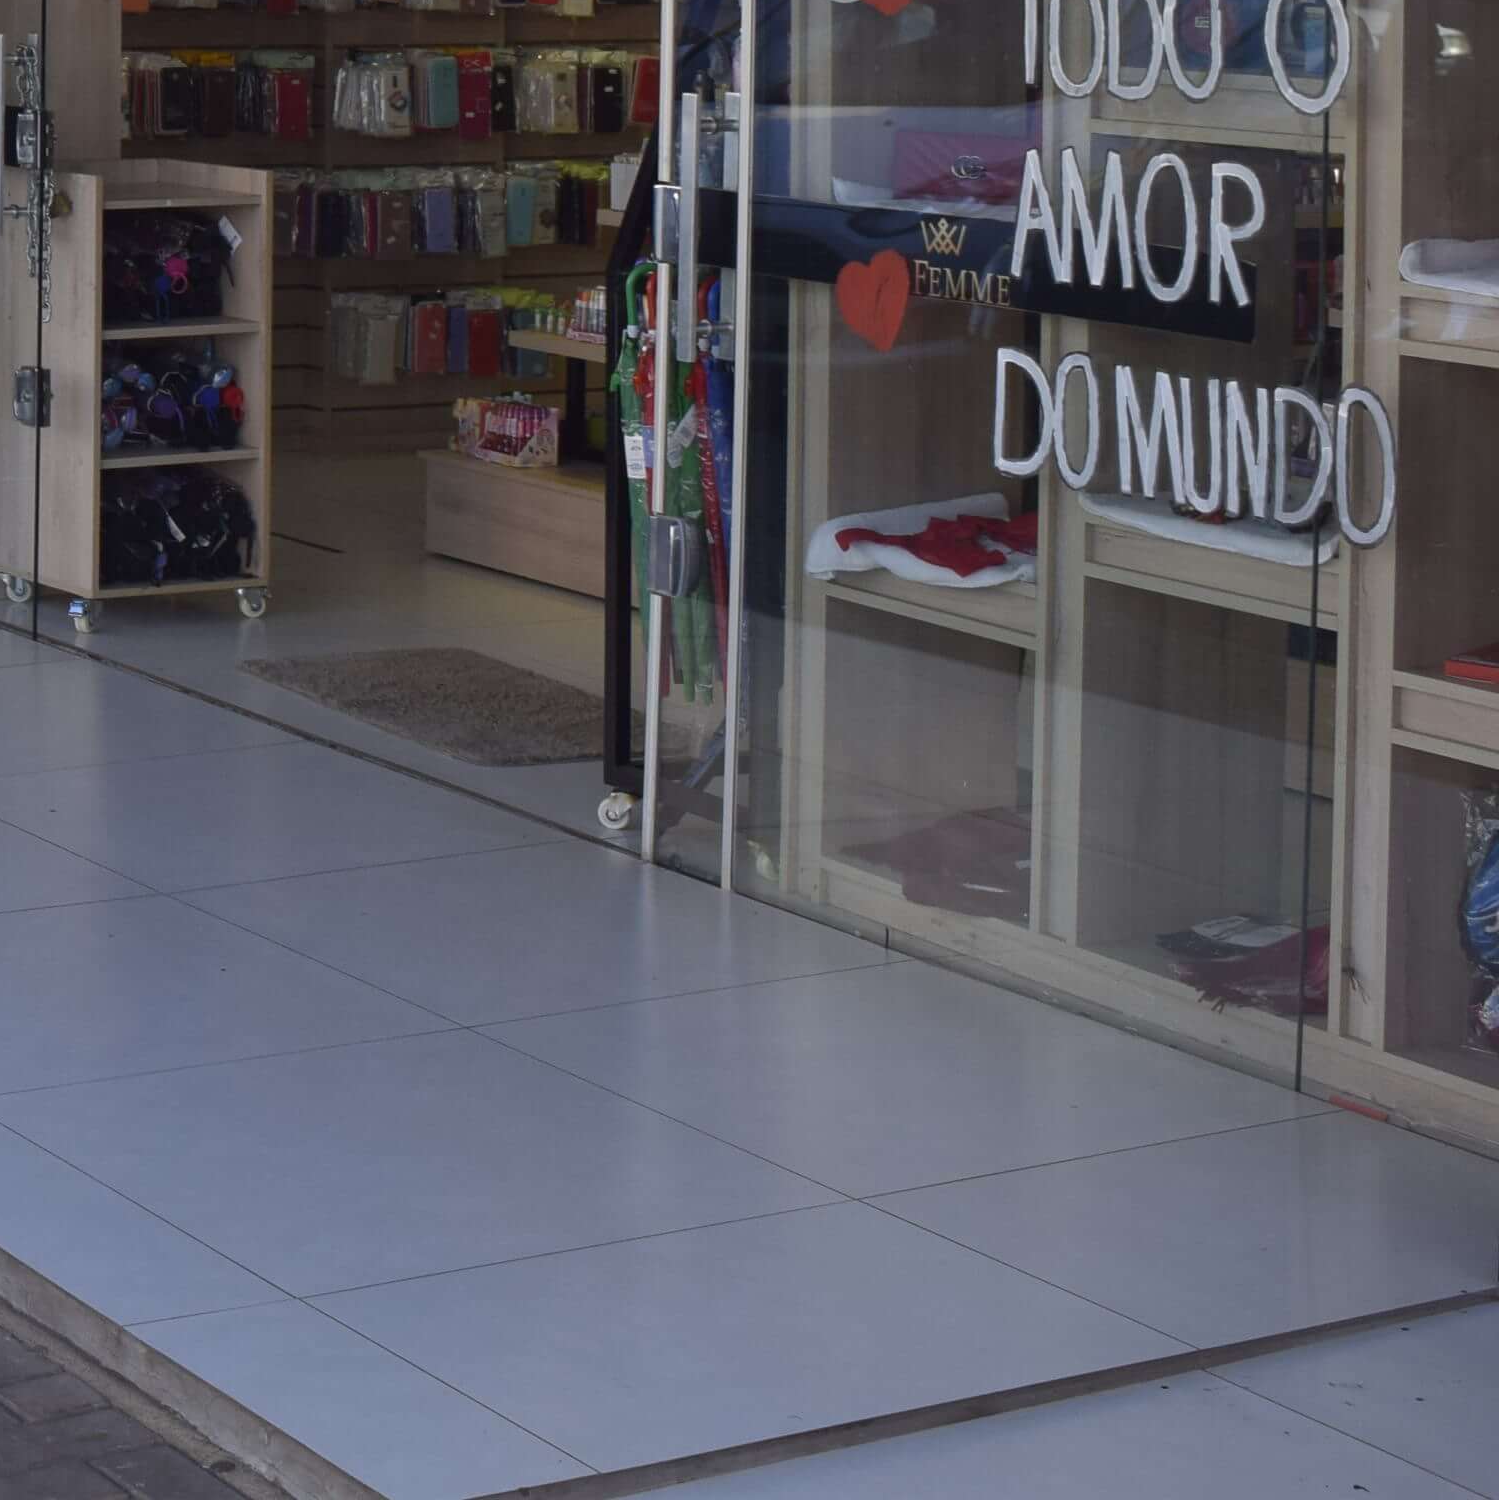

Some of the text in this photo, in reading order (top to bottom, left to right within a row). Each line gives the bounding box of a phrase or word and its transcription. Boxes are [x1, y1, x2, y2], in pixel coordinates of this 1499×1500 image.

[913, 259, 1012, 307] FEMME
[1009, 146, 1267, 309] AMOR
[993, 347, 1398, 549] DO MUNDO
